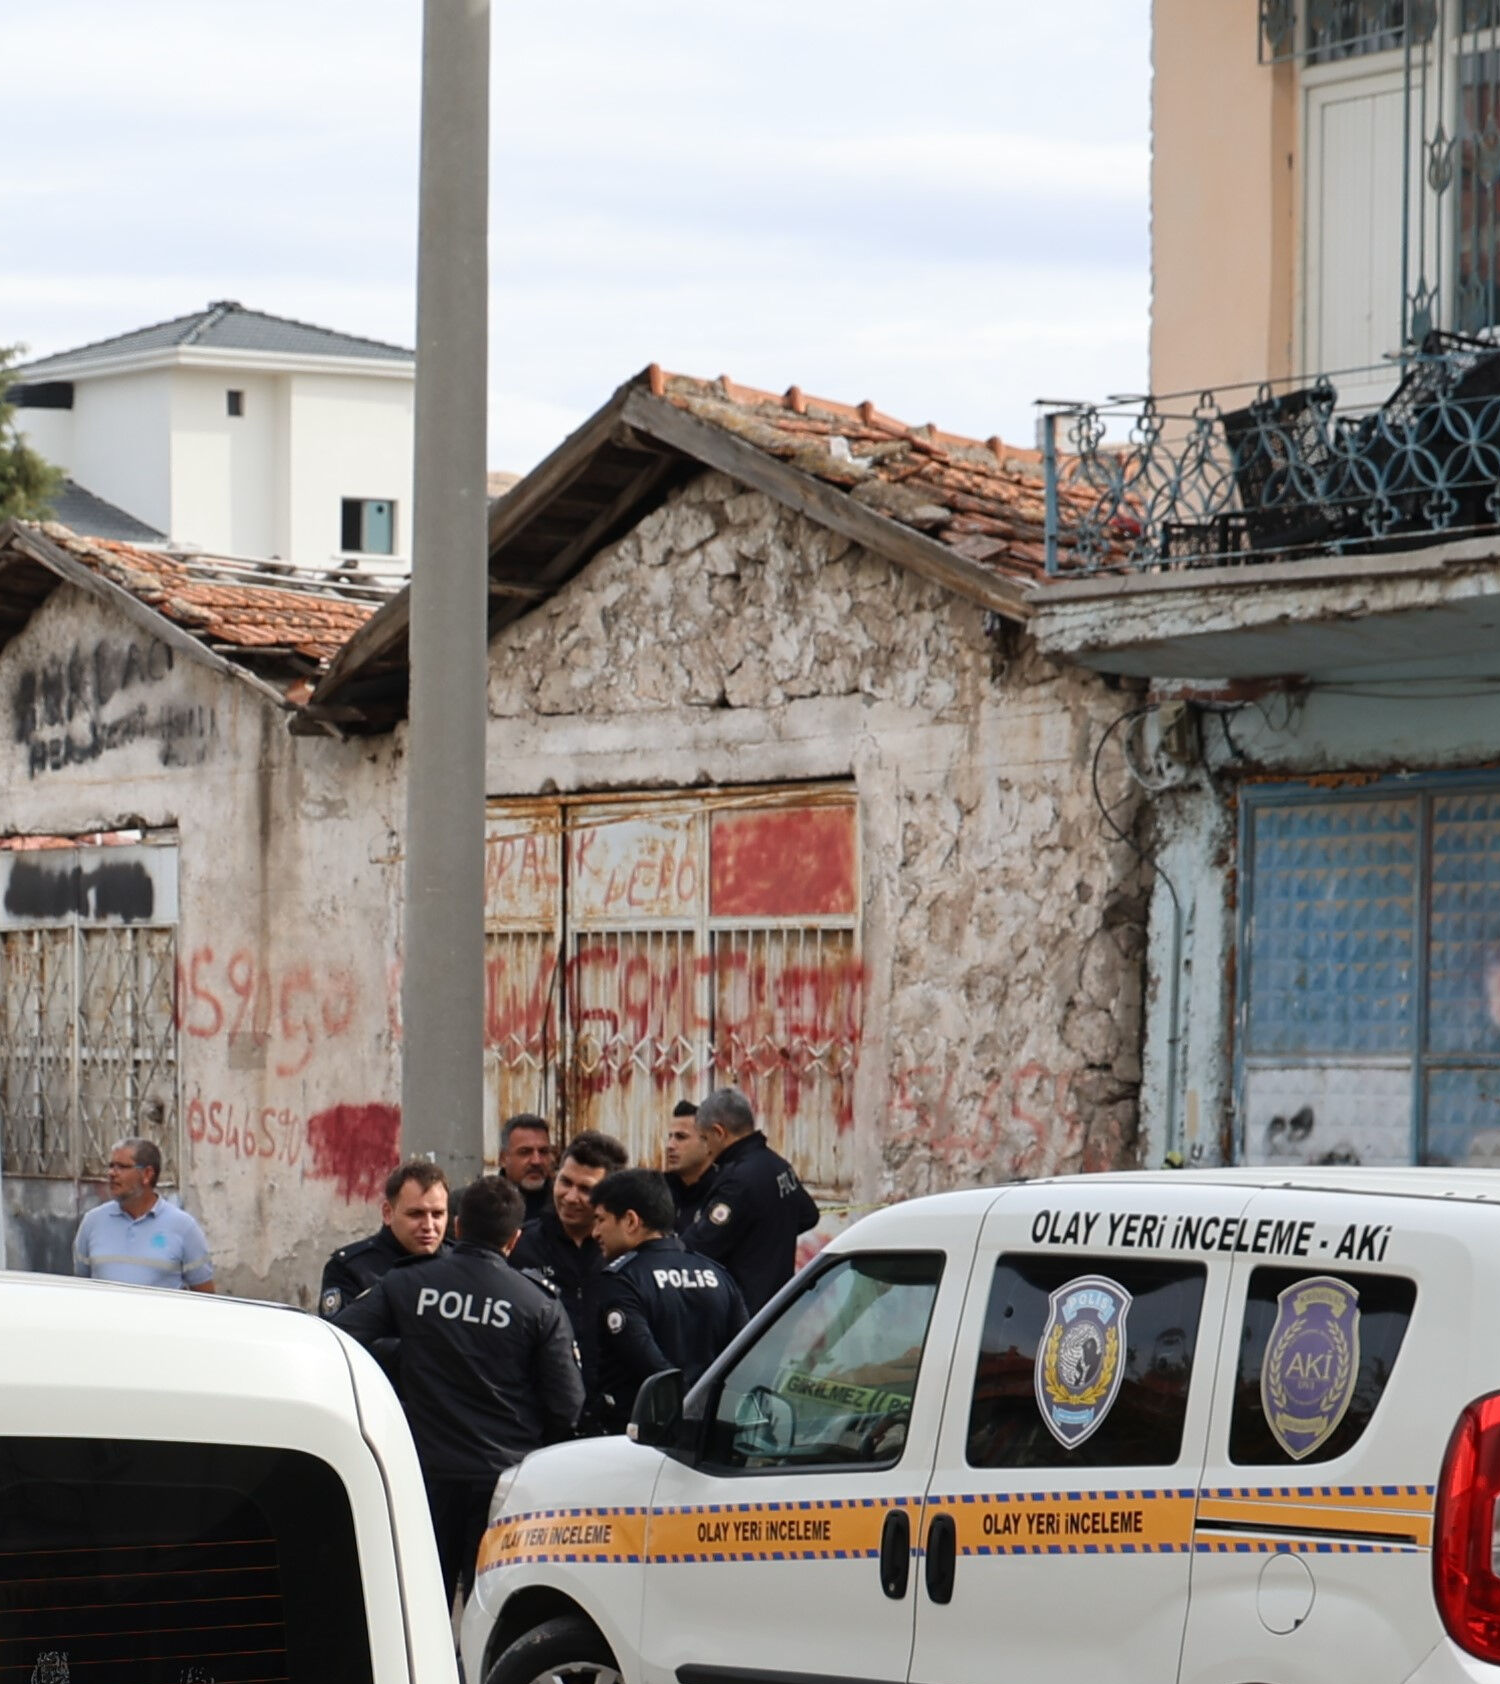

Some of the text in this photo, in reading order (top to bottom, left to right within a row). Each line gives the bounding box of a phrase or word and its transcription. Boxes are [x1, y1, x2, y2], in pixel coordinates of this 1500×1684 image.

[1031, 1209, 1101, 1246] OLAY
[697, 1521, 732, 1543] OLAY
[982, 1512, 1022, 1536] OLAY
